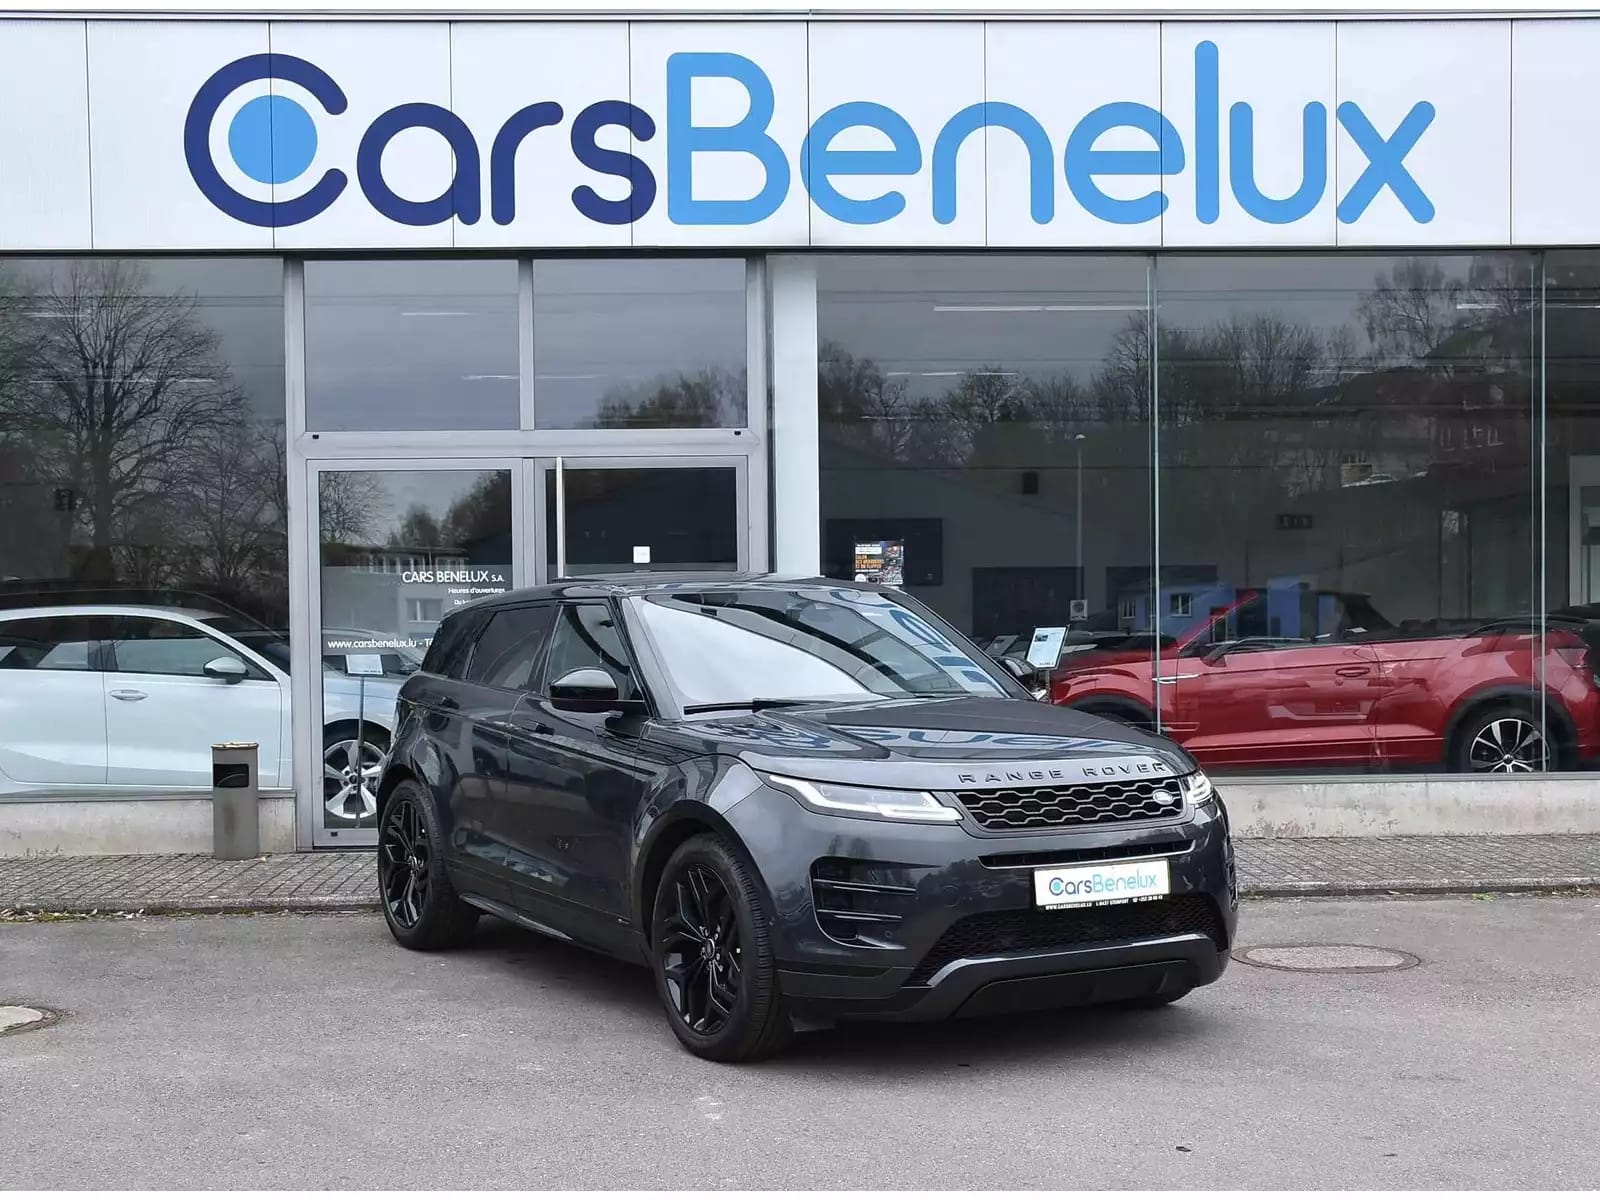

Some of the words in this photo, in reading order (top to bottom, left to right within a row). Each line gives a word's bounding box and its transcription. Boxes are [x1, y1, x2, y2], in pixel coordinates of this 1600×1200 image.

[184, 40, 1436, 227] CarsBenelux
[402, 571, 434, 583] CARS
[436, 571, 489, 583] BENELUX
[327, 638, 417, 649] www.carsbenelux.lu
[958, 770, 1064, 784] RANGE
[1082, 762, 1167, 777] ROVER
[1049, 870, 1157, 897] CarsBenelux
